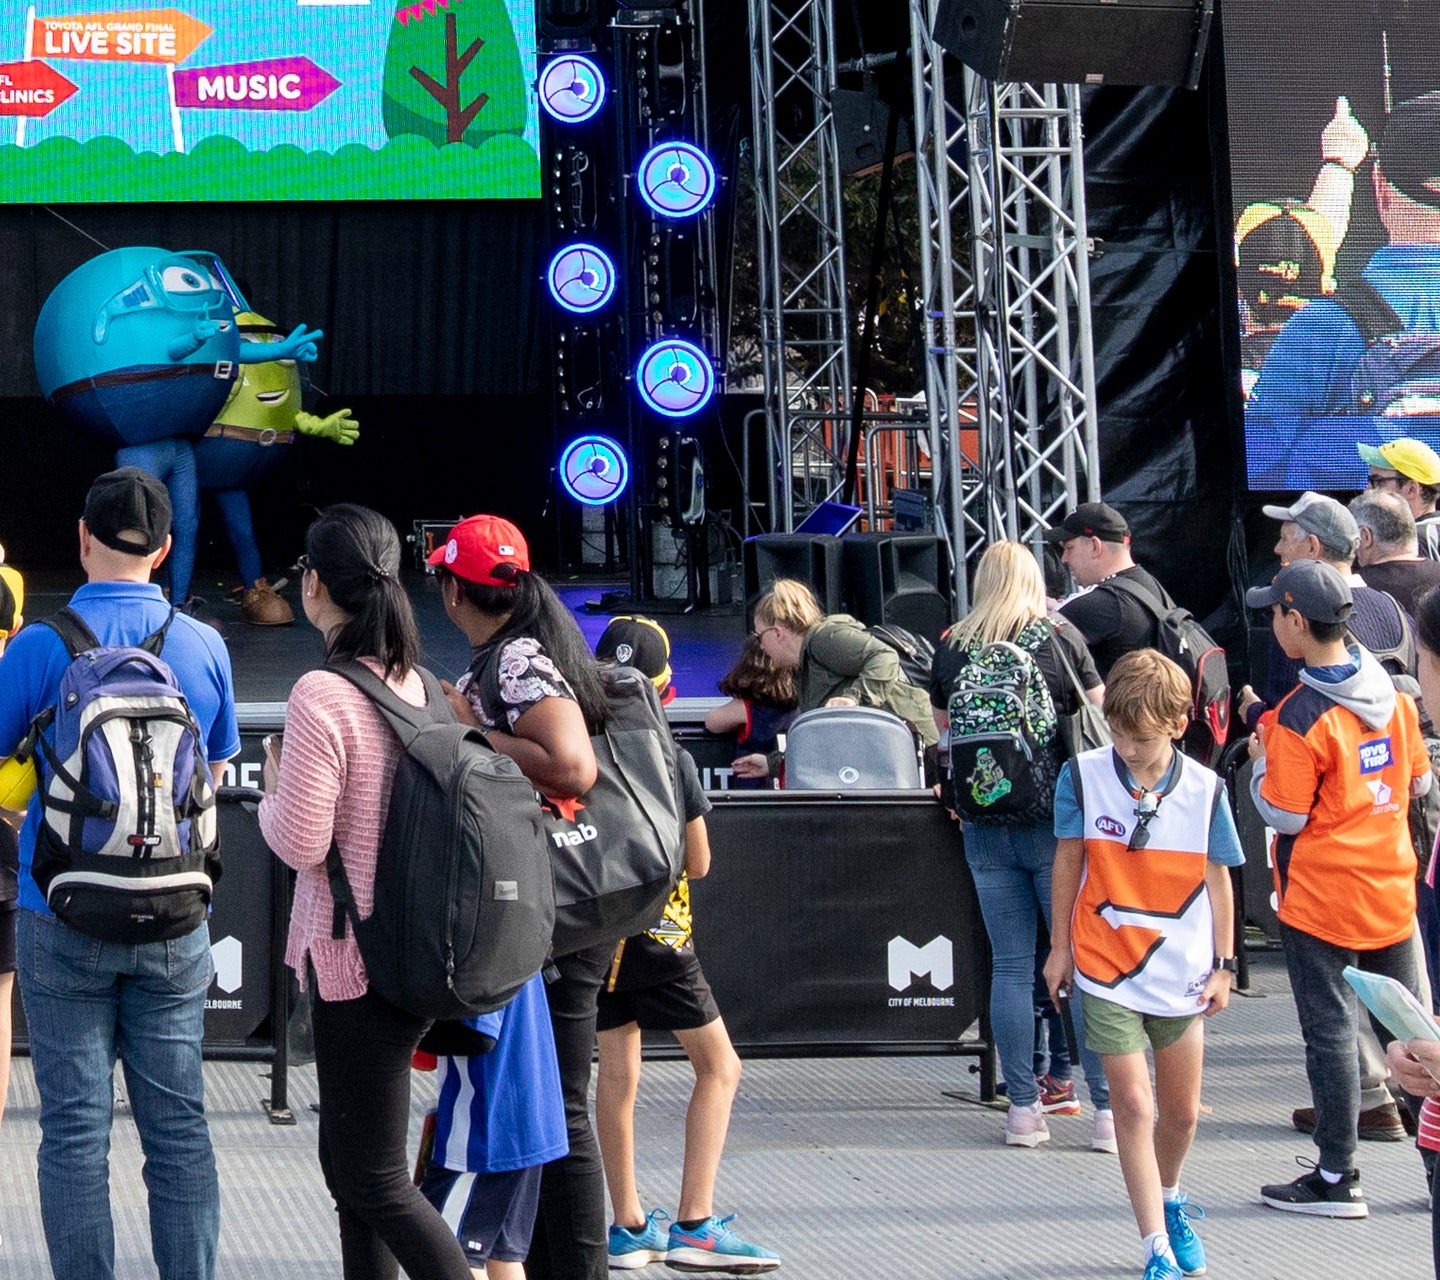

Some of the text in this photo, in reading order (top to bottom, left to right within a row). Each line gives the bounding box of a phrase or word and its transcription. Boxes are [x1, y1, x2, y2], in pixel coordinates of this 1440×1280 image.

[44, 21, 176, 32] TOYOTA AFL GRAND FINAL
[45, 31, 177, 56] LIVE SITE
[197, 74, 302, 101] MUSIC
[552, 823, 598, 848] nab
[1097, 819, 1124, 836] AFL
[888, 997, 955, 1007] CITY OF MELBOURNE
